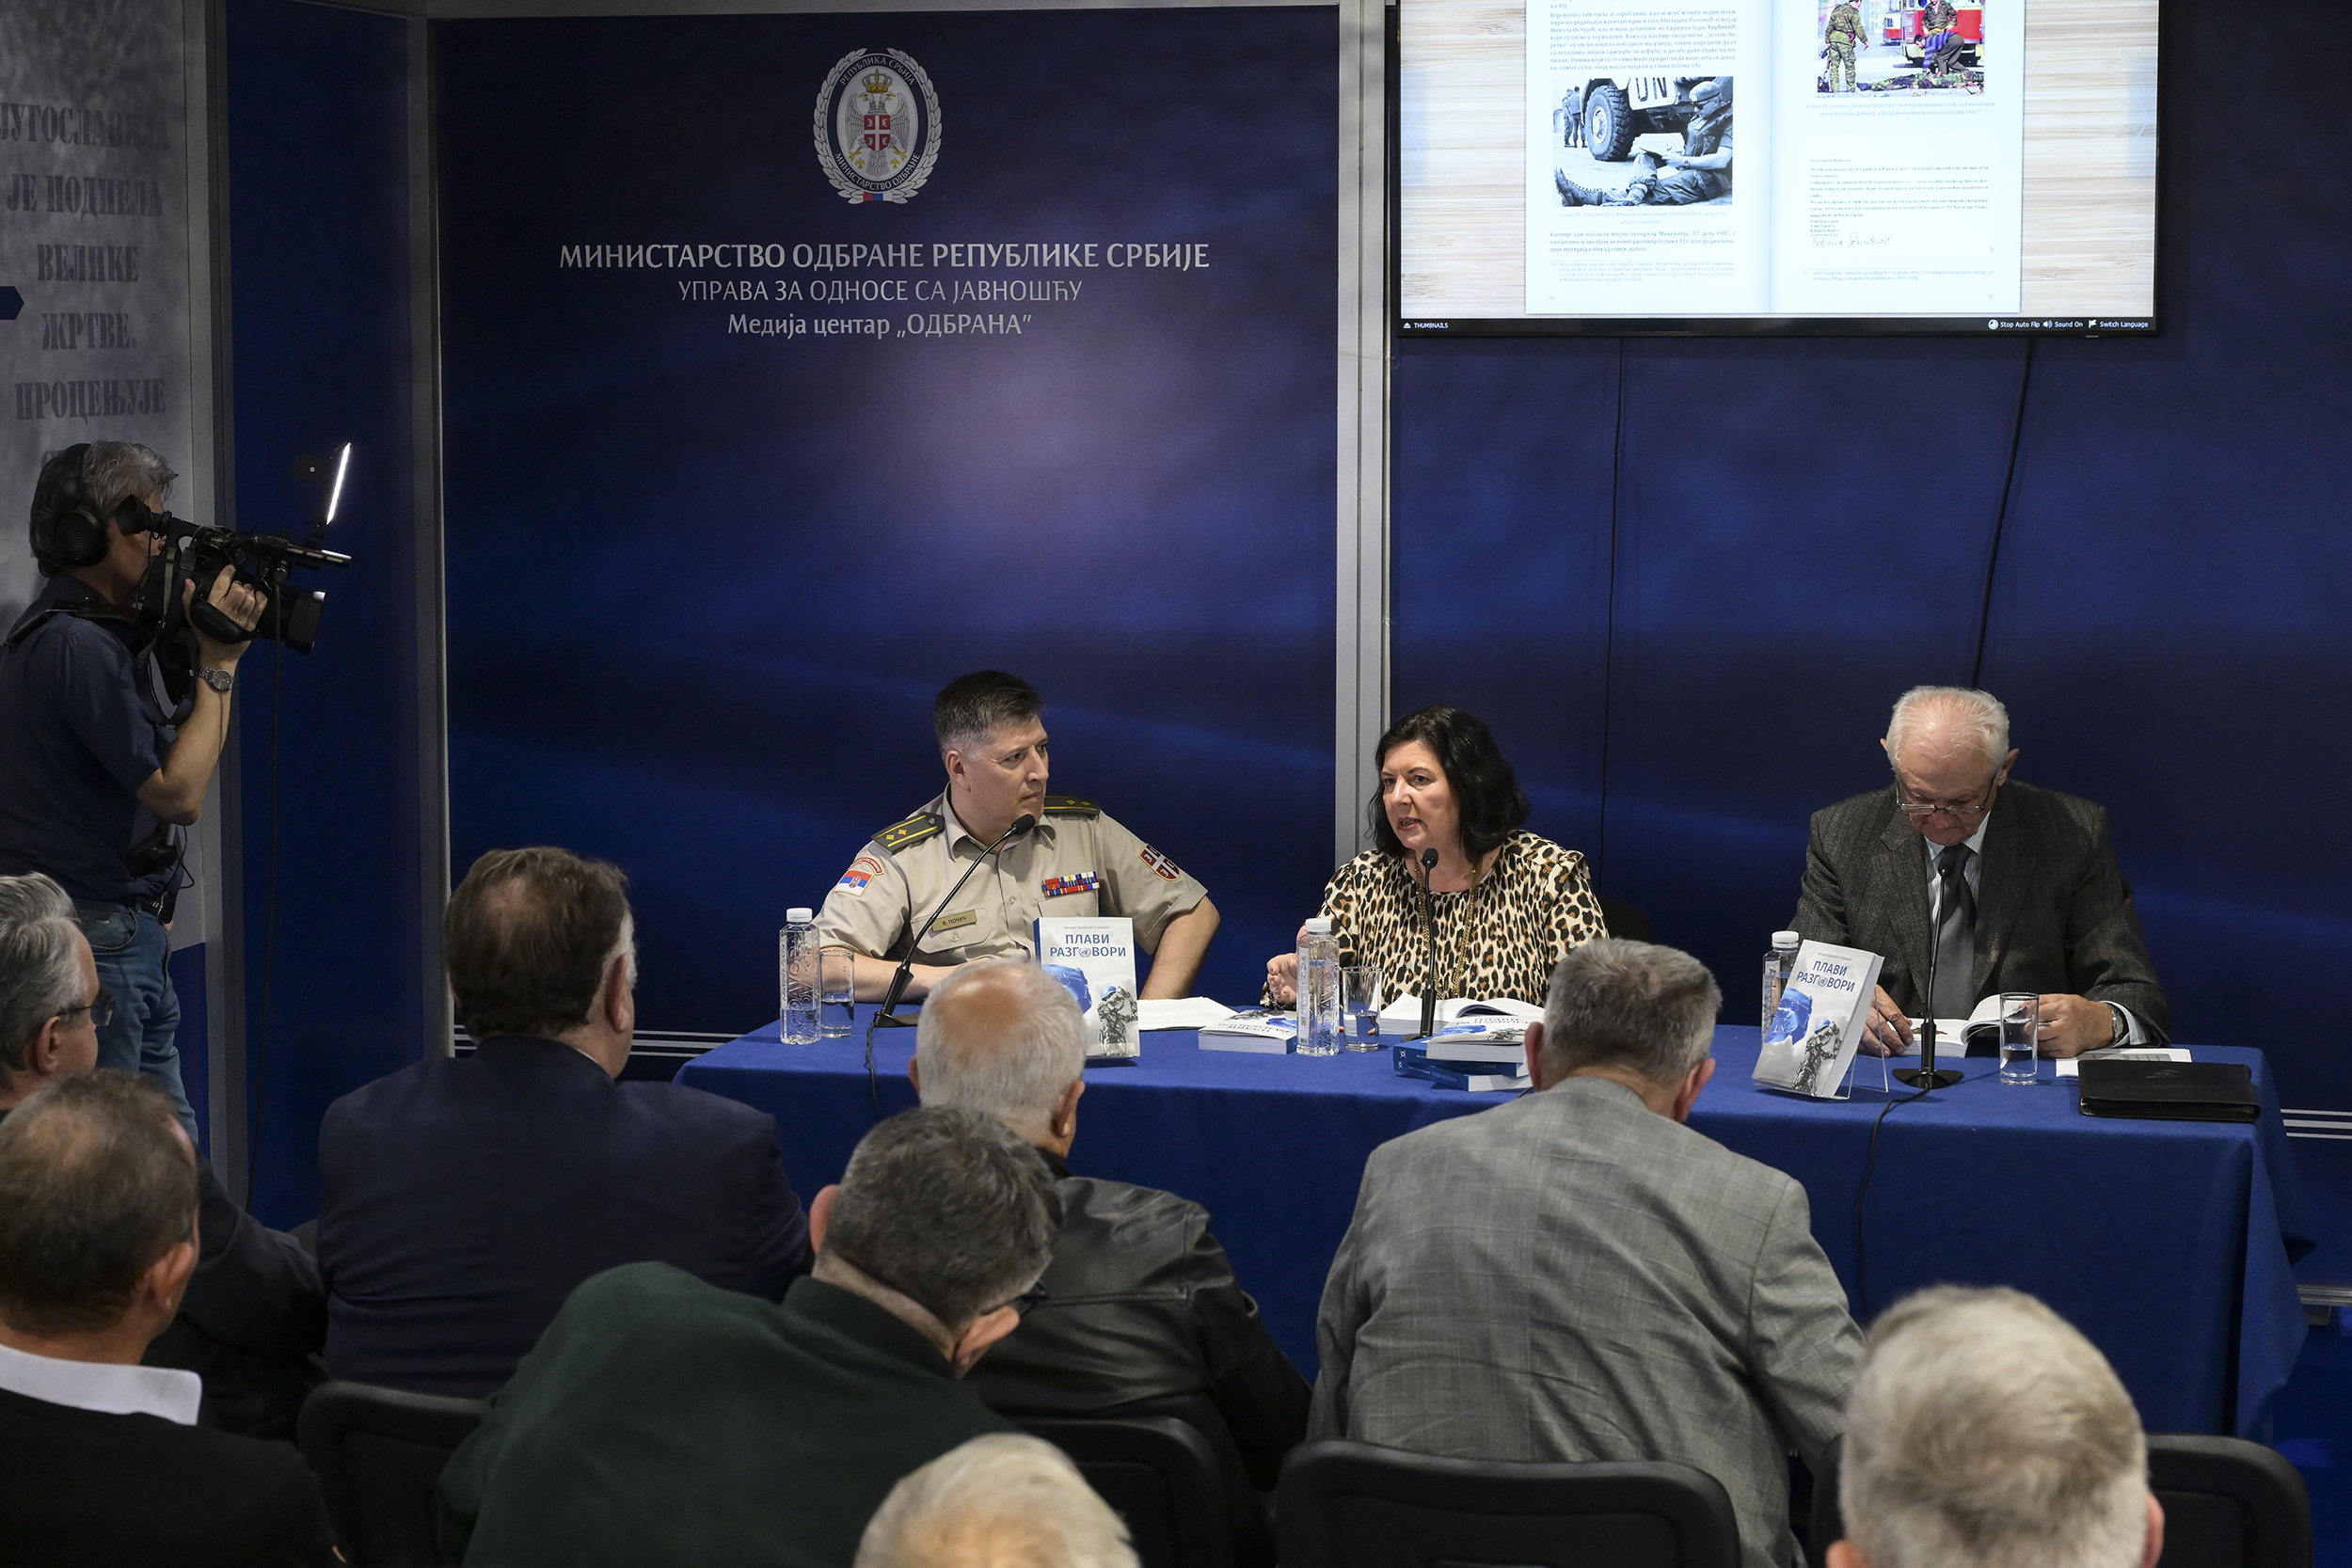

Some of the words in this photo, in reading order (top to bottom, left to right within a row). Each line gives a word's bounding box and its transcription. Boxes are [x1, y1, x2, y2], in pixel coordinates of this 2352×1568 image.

[839, 55, 887, 86] РЕПУБЛИКА
[888, 58, 915, 86] СРБИЈА
[834, 152, 892, 191] МИНИСТАРСТВО
[892, 152, 921, 186] ОДБРАНЕ
[6, 173, 37, 213] ЈЕ
[46, 175, 163, 222] ПОДНЕЛА
[36, 243, 139, 283] ВЕЛИКЕ
[559, 243, 785, 268] МИНИСТАРСТВО
[792, 243, 924, 272] ОДБРАНЕ
[932, 243, 1099, 268] РЕПУБЛИКЕ
[1106, 243, 1210, 272] СРБИЈЕ
[677, 279, 769, 301] УПРАВА
[774, 279, 803, 301] ЗА
[809, 279, 908, 304] ОДНОСЕ
[914, 279, 946, 301] СА
[951, 279, 1083, 305] ЈАВНОШЋУ
[40, 312, 137, 350] ЖРТВЕ.
[727, 313, 807, 340] Медија
[814, 319, 891, 341] центар
[14, 378, 167, 425] ПРОЦЕЊУЈЕ
[1065, 934, 1109, 944] ПЛАВИ
[1812, 960, 1848, 976] ПЛАВИ
